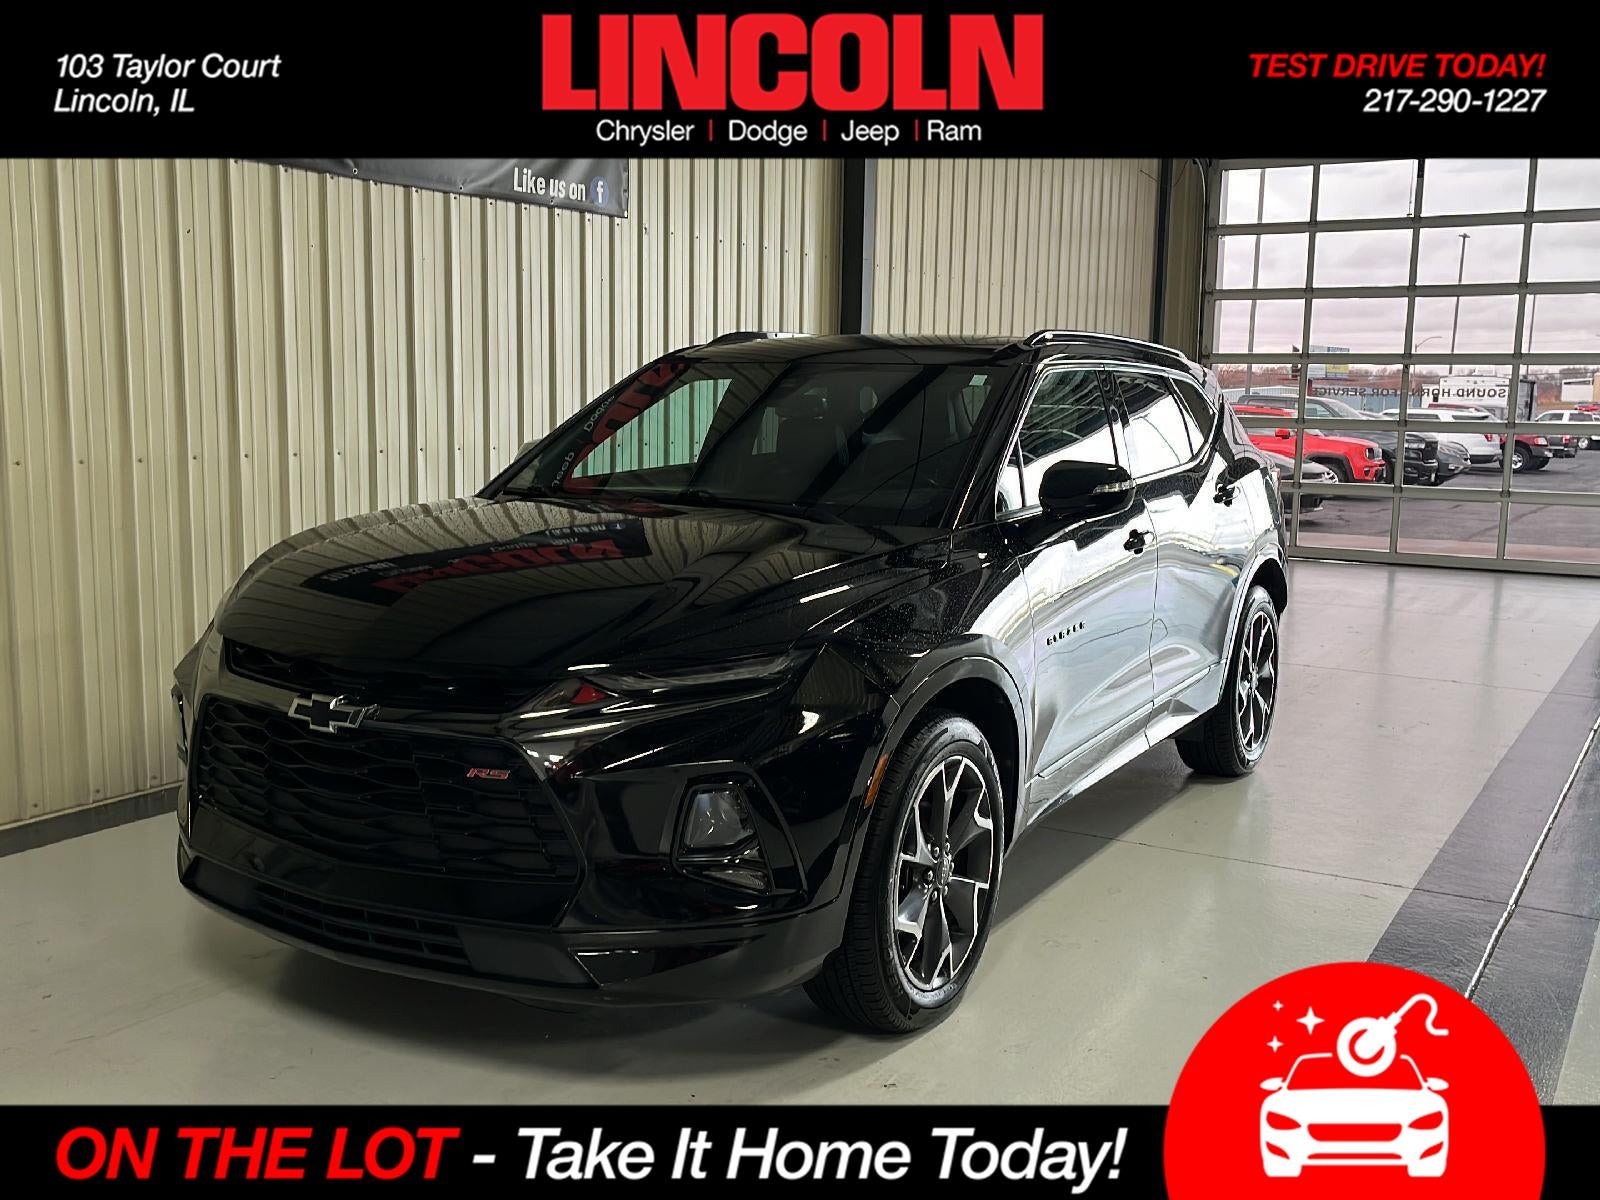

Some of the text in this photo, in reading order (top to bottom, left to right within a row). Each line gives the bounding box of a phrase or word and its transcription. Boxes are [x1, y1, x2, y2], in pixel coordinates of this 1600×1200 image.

[513, 167, 546, 195] Like
[549, 178, 566, 199] us
[568, 182, 586, 201] on
[466, 767, 511, 780] RS
